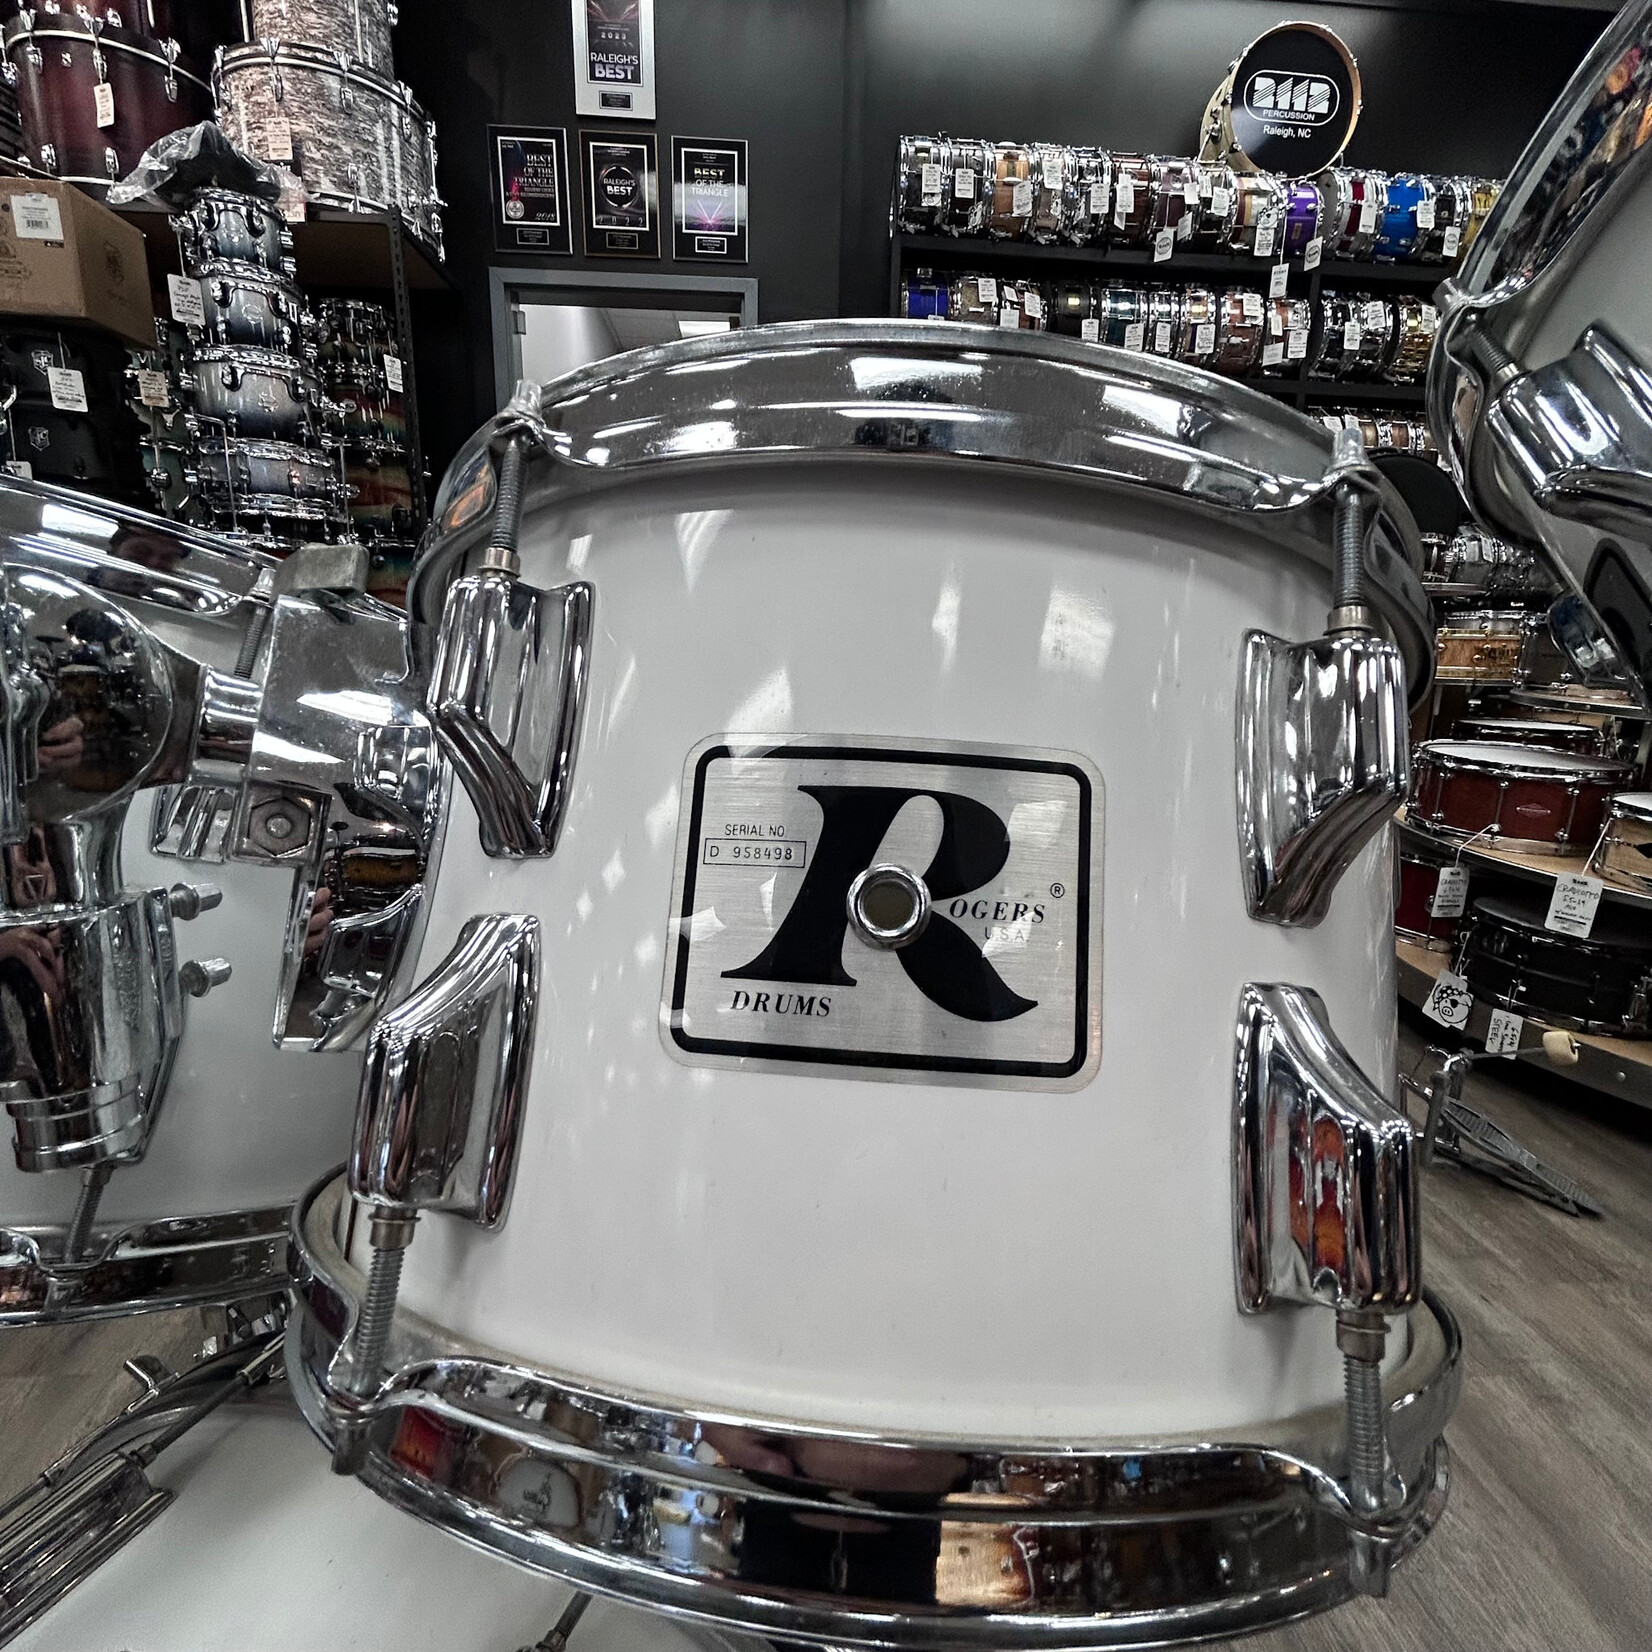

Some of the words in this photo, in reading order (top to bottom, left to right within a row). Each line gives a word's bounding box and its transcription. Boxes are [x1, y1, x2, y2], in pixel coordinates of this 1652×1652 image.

[590, 52, 639, 65] RALEIGH'S
[595, 64, 635, 80] BEST
[1252, 76, 1331, 114] 2112
[1262, 109, 1315, 121] PERCUSSION
[1263, 125, 1296, 139] Raleigh,
[1297, 128, 1312, 139] NC
[526, 153, 553, 167] BEST
[523, 167, 536, 177] OF
[537, 167, 554, 178] THE
[693, 167, 726, 179] BEST
[513, 176, 555, 188] TRIANGLE
[603, 177, 636, 187] RALEIGH'S
[695, 179, 707, 187] OF
[709, 180, 724, 188] THE
[606, 186, 633, 196] BEST
[691, 187, 729, 197] TRIANGLE
[724, 823, 765, 837] SERIAL
[769, 825, 785, 837] NO
[709, 845, 720, 858] D
[733, 846, 793, 861] 958498
[730, 989, 832, 1018] DRUMS
